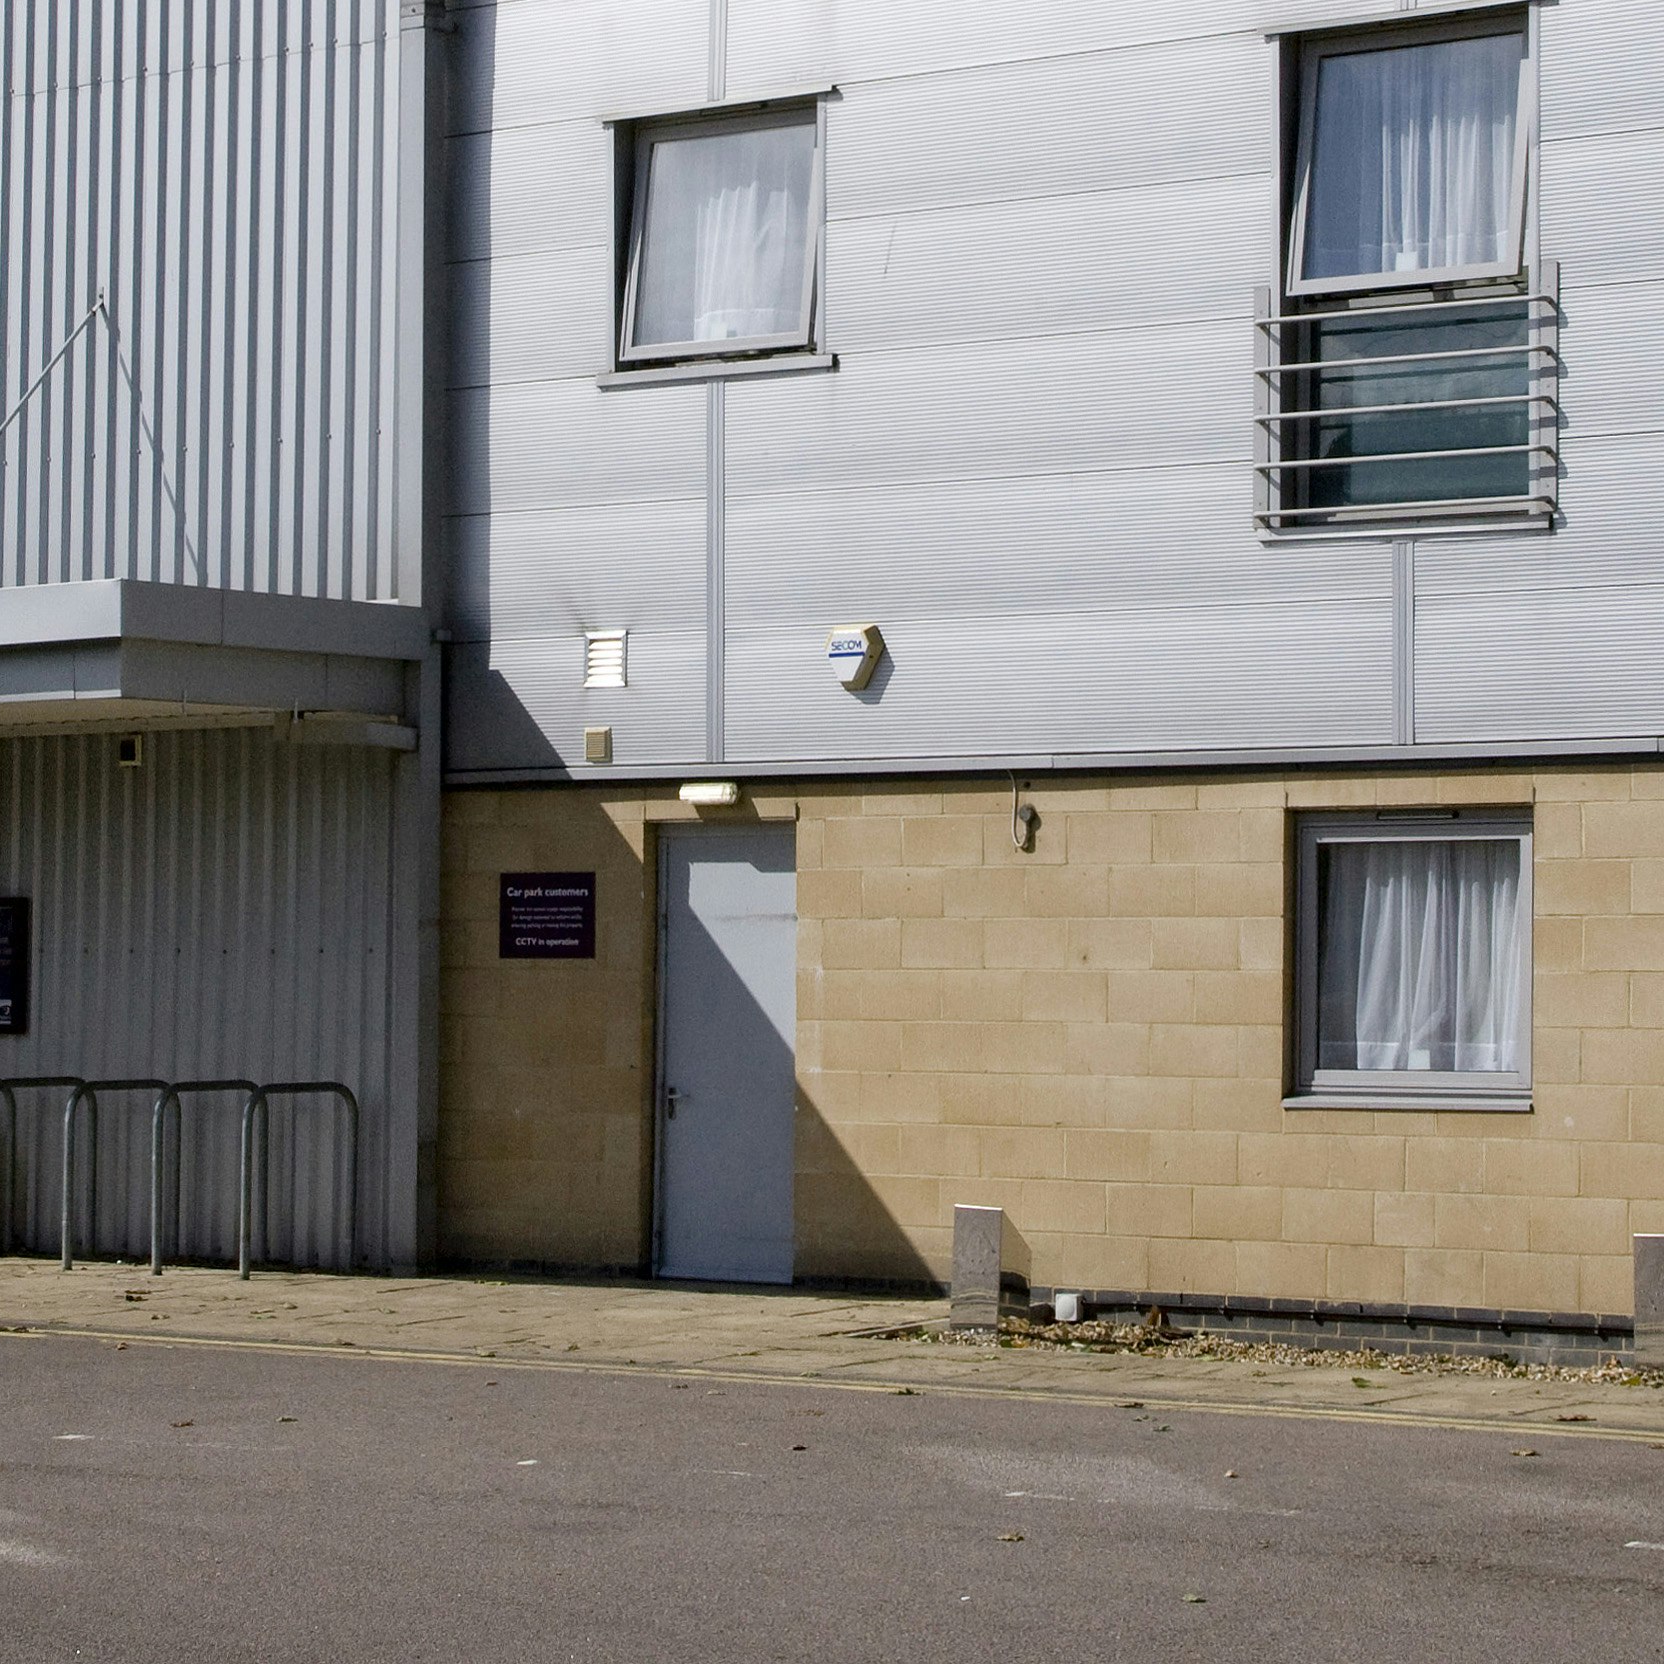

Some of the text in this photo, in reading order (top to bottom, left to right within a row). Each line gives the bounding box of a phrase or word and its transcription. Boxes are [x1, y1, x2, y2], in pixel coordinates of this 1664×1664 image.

[831, 639, 862, 651] SECOM
[507, 887, 589, 899] Car park customers
[515, 937, 579, 948] CCTV in operation
